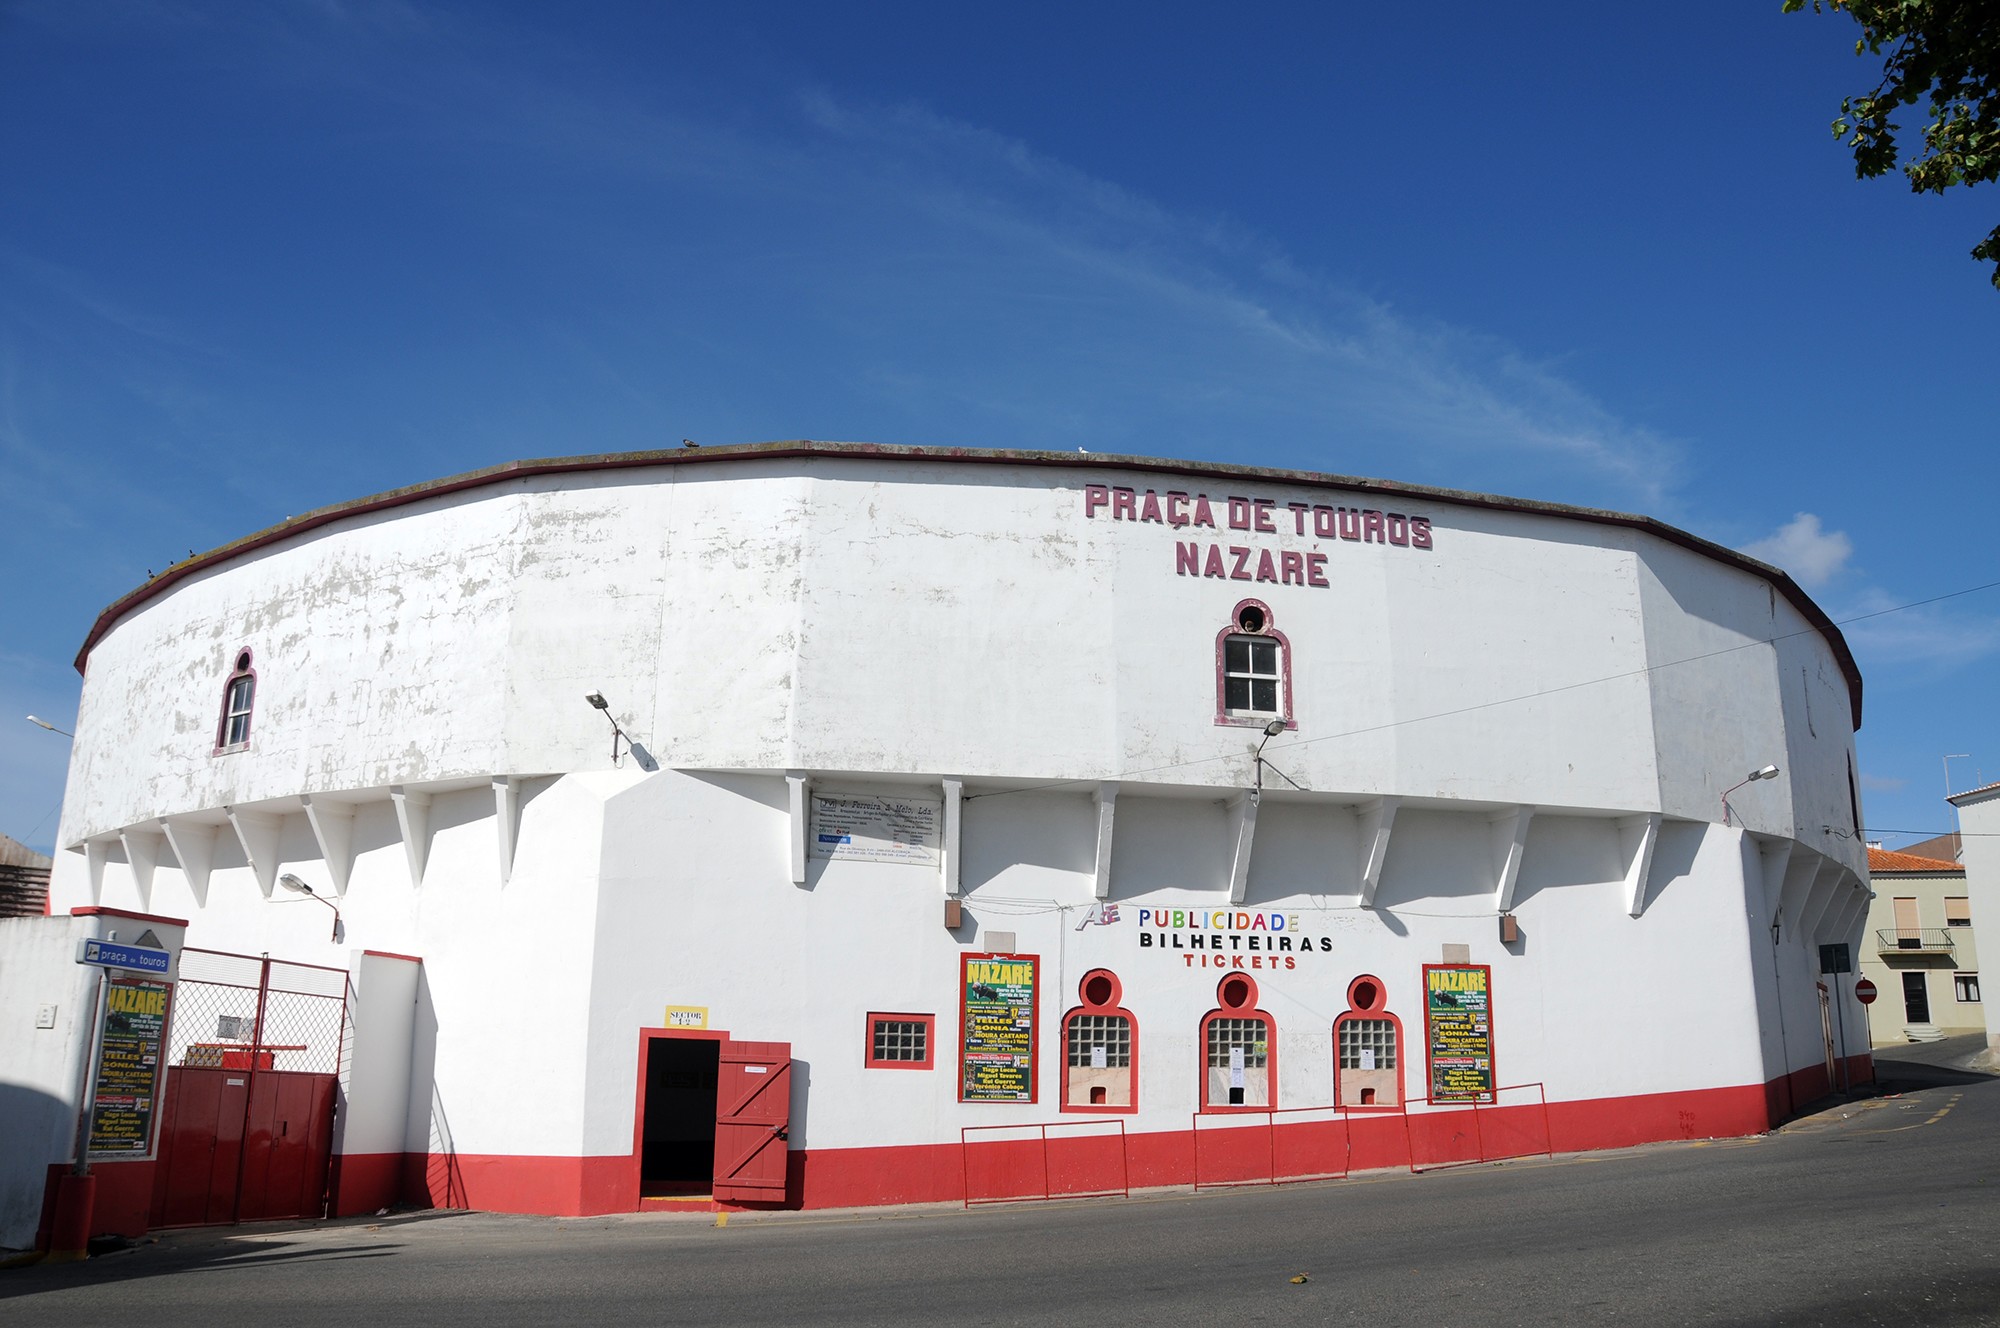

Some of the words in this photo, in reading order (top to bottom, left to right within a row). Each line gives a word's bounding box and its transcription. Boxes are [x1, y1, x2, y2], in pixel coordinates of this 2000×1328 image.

[1085, 484, 1216, 530] PRAÇA
[1228, 496, 1276, 533] DE
[1288, 501, 1432, 551] TOUROS
[1139, 909, 1299, 932] PUBLICIDADE
[1140, 932, 1333, 952] BILHETEIRAS
[101, 952, 127, 964] praça
[140, 954, 166, 968] touros
[1183, 954, 1296, 970] TICKETS
[967, 963, 1033, 985] NAZARÉ
[1430, 970, 1486, 991] NAZARÉ
